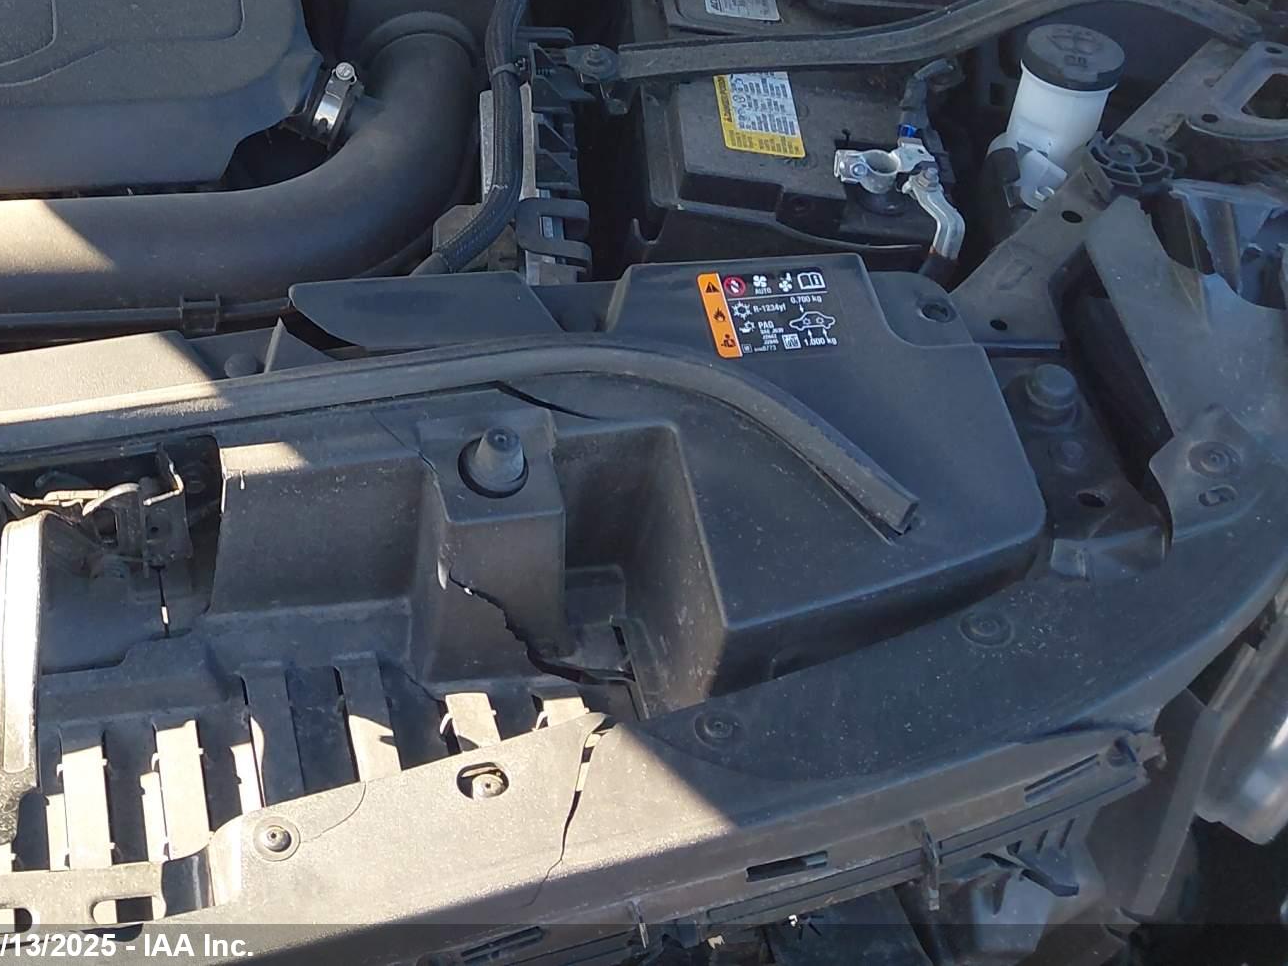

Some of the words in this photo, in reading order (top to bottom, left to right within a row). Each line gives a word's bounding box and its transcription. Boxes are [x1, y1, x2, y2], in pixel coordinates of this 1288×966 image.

[755, 287, 772, 295] AUTO
[812, 294, 823, 303] kg
[753, 303, 786, 313] R-1234yf
[758, 320, 775, 329] PAG
[826, 336, 838, 346] kg
